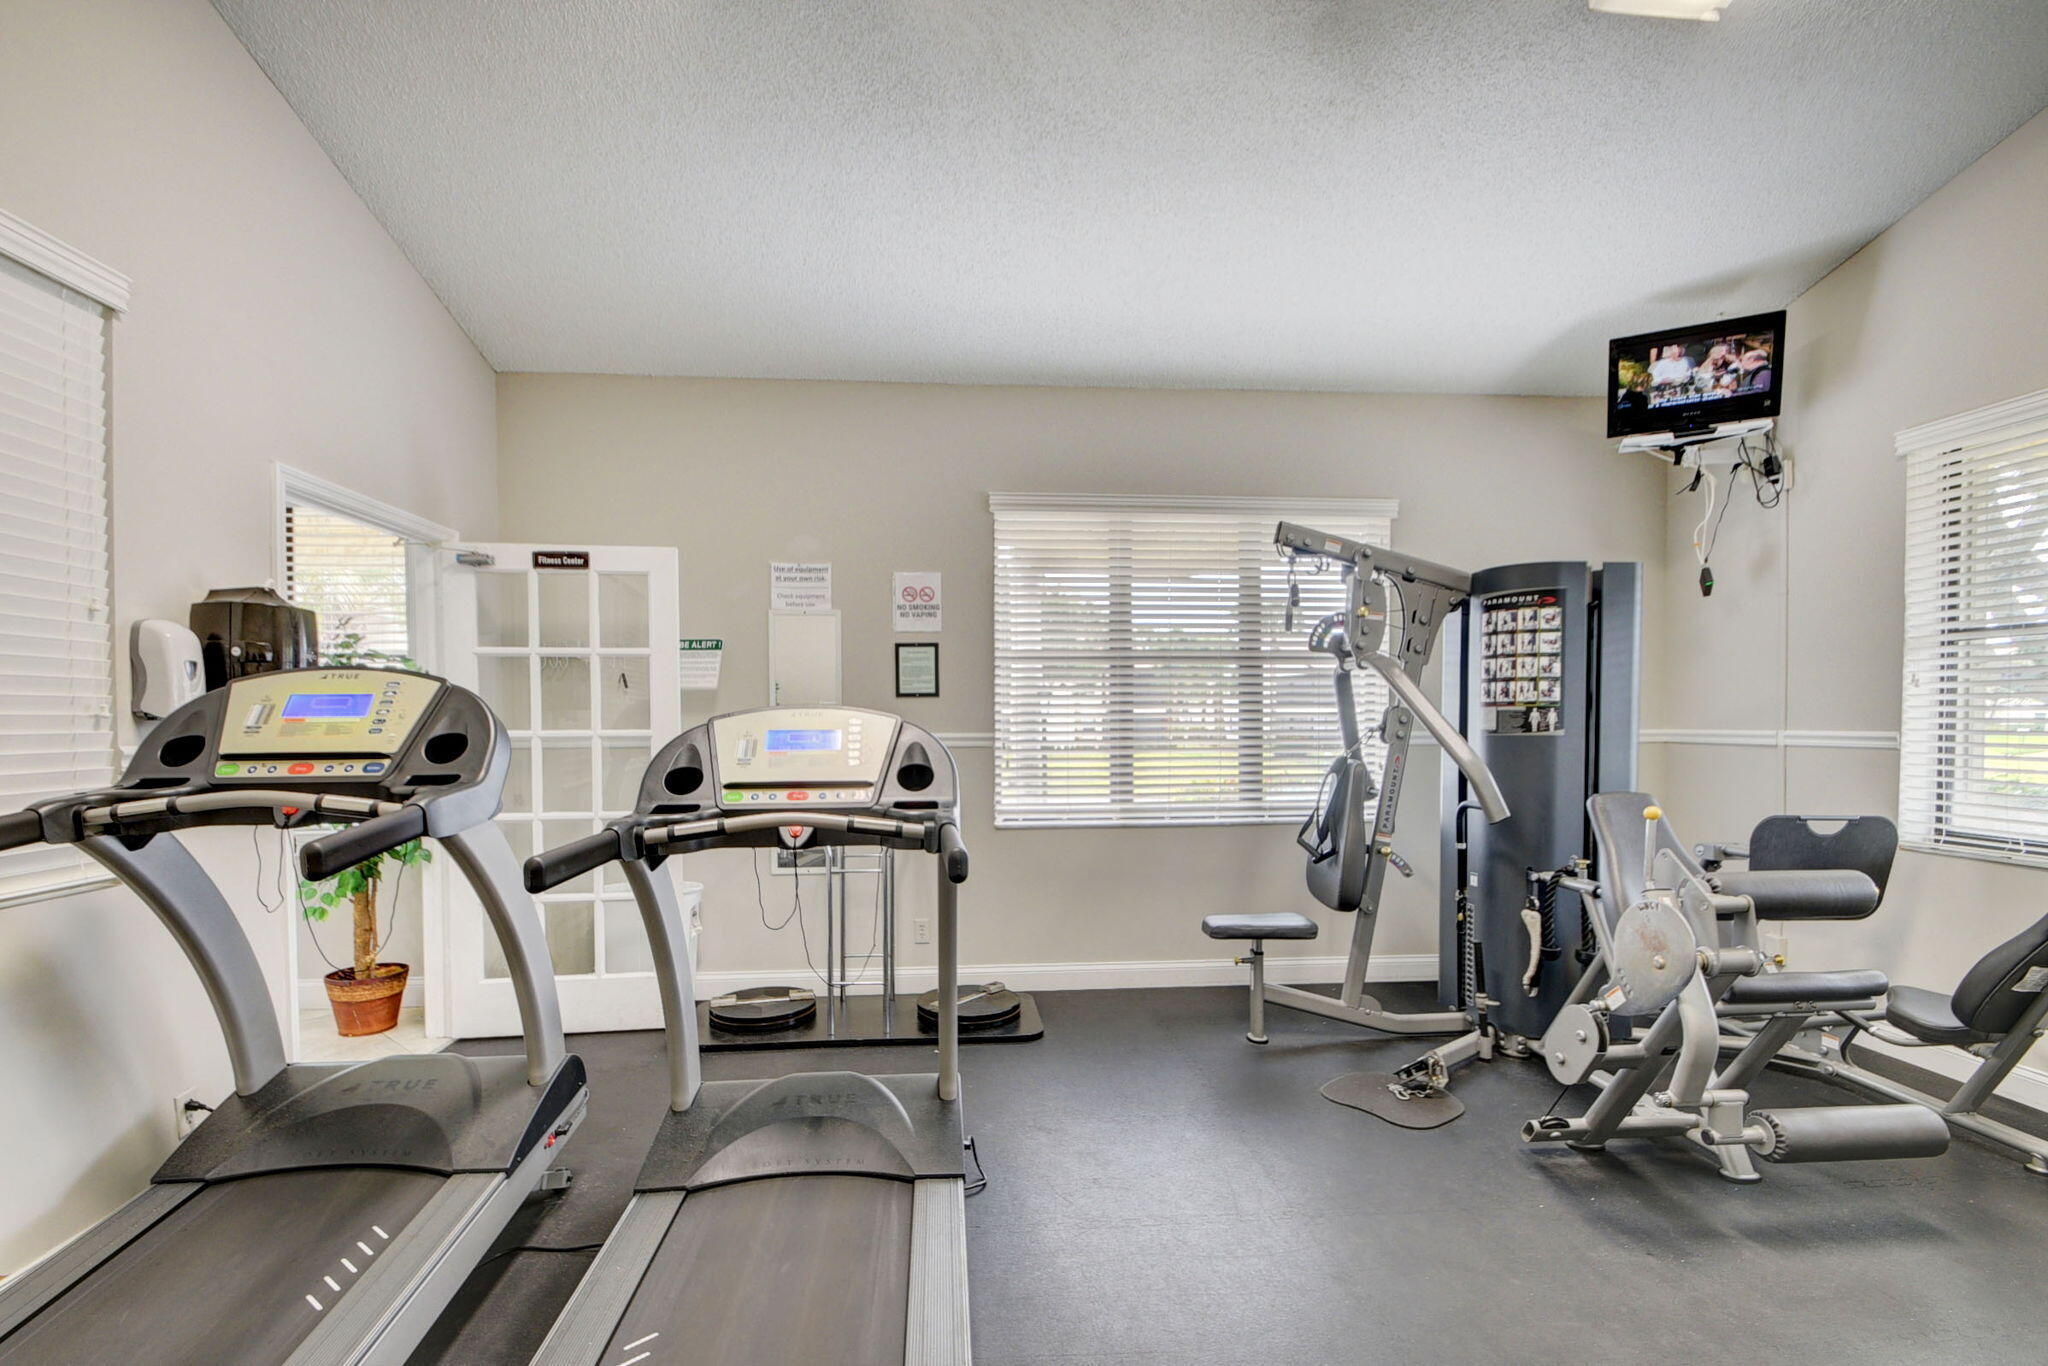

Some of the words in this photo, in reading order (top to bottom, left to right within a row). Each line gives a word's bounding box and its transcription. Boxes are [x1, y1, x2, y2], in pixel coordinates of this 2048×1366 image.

[538, 555, 561, 565] Fitness
[563, 556, 584, 566] Center
[787, 565, 793, 573] of
[795, 565, 829, 575] equipment
[795, 593, 825, 601] equipment
[1482, 594, 1540, 606] PARAMOUNT
[1382, 767, 1399, 829] PARAMOUNT
[370, 1078, 439, 1092] TRUE
[796, 1093, 857, 1105] TRUE
